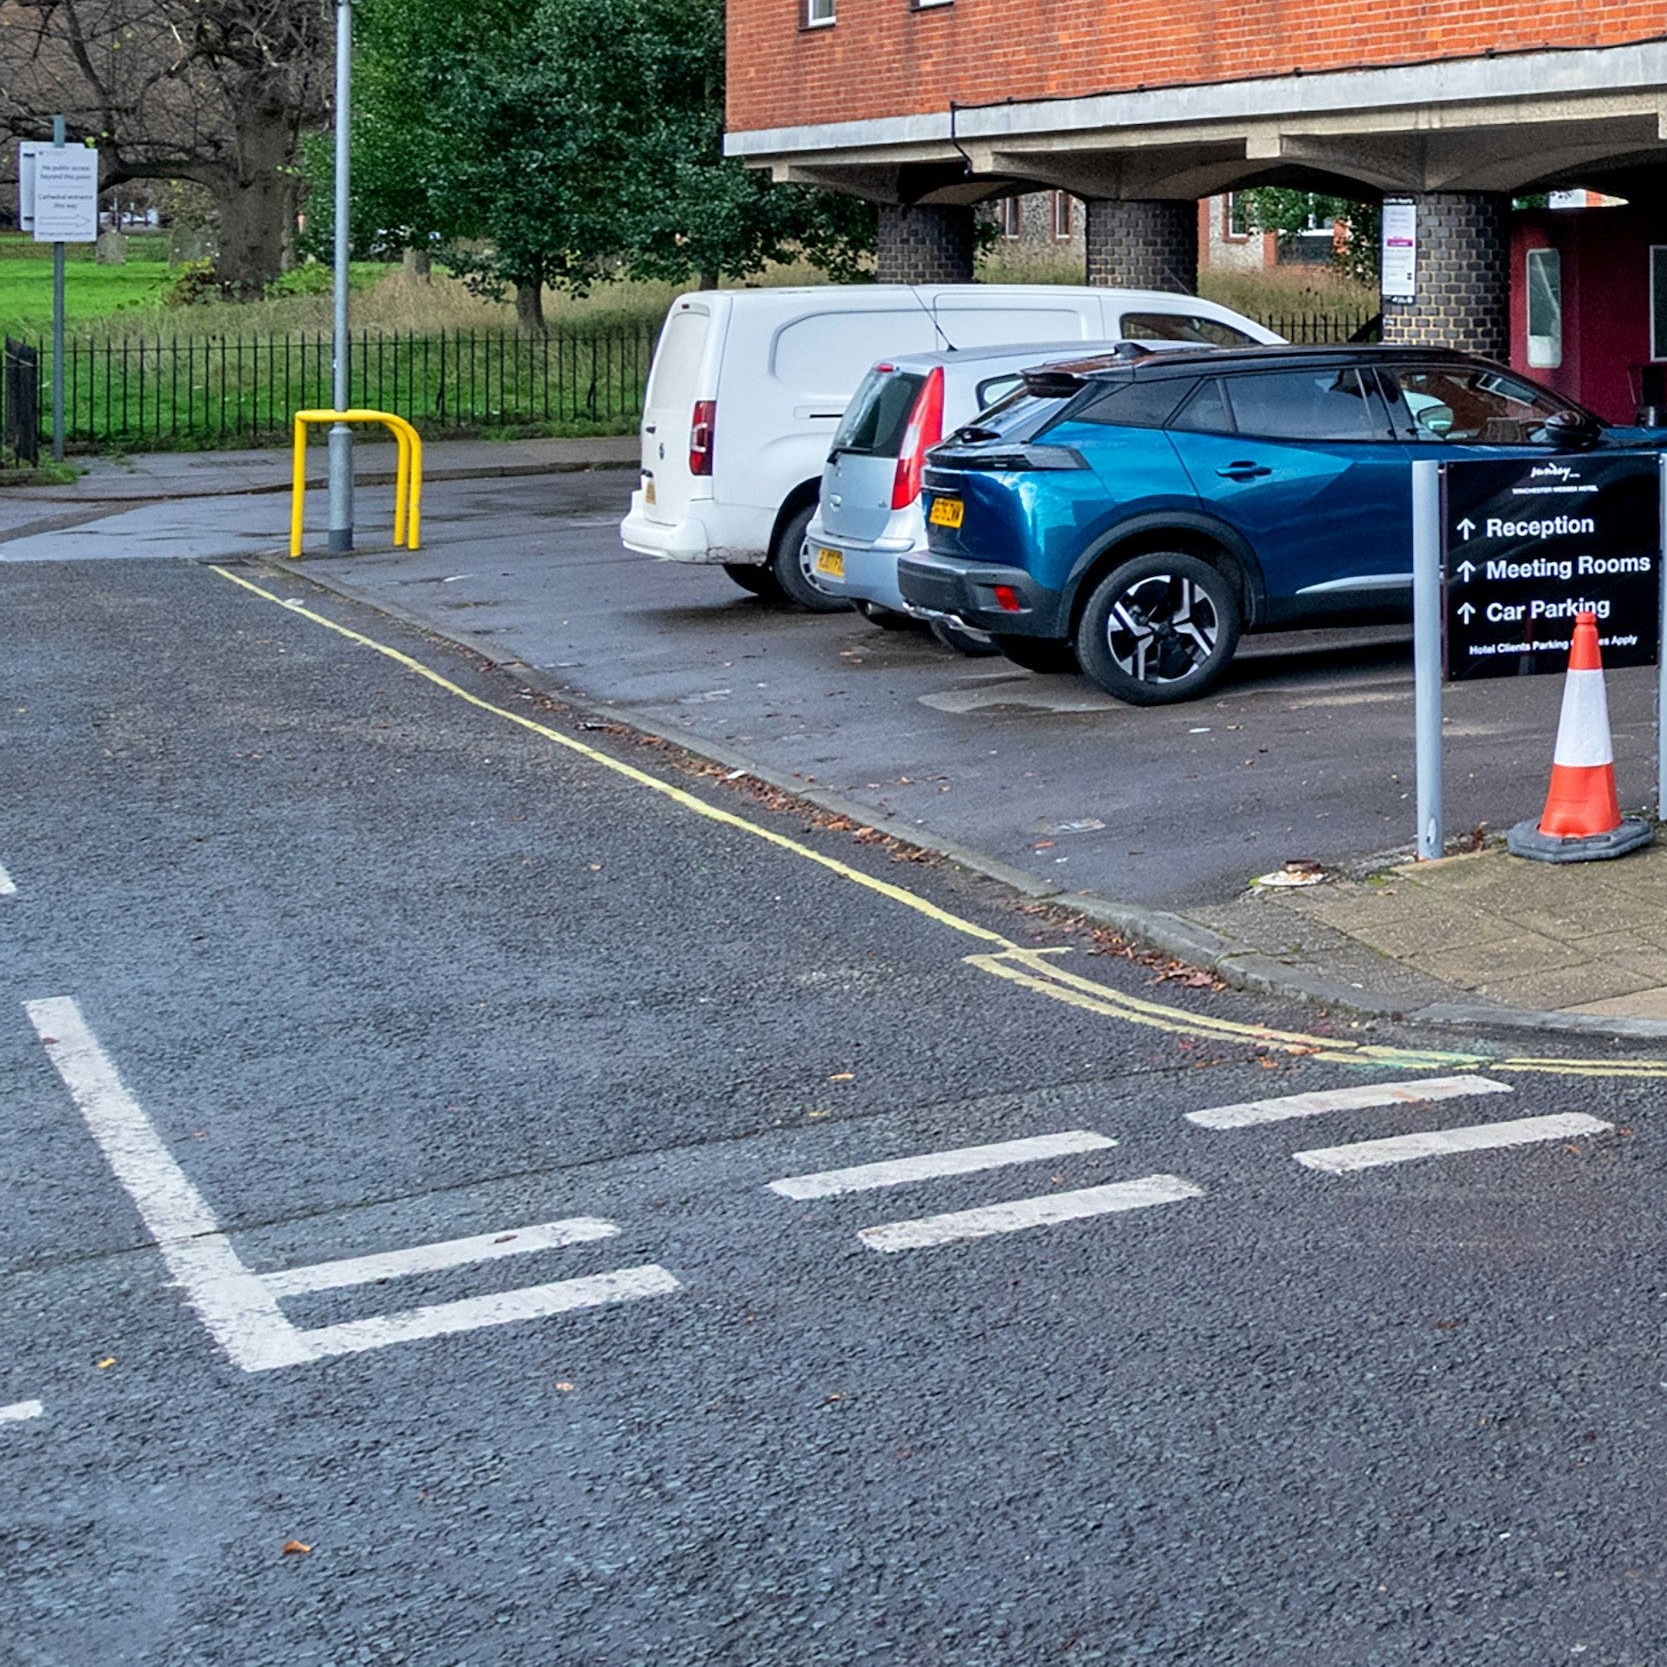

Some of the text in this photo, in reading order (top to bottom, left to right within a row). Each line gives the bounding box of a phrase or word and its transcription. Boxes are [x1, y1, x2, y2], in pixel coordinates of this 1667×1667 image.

[1486, 515, 1594, 539] Reception
[1486, 555, 1651, 580] Meeting Rooms
[1486, 597, 1610, 622] Car Parking
[1469, 645, 1496, 655] Hotel
[1497, 642, 1530, 653] Clients
[1532, 639, 1569, 651] Parking
[1611, 634, 1638, 646] Apply
